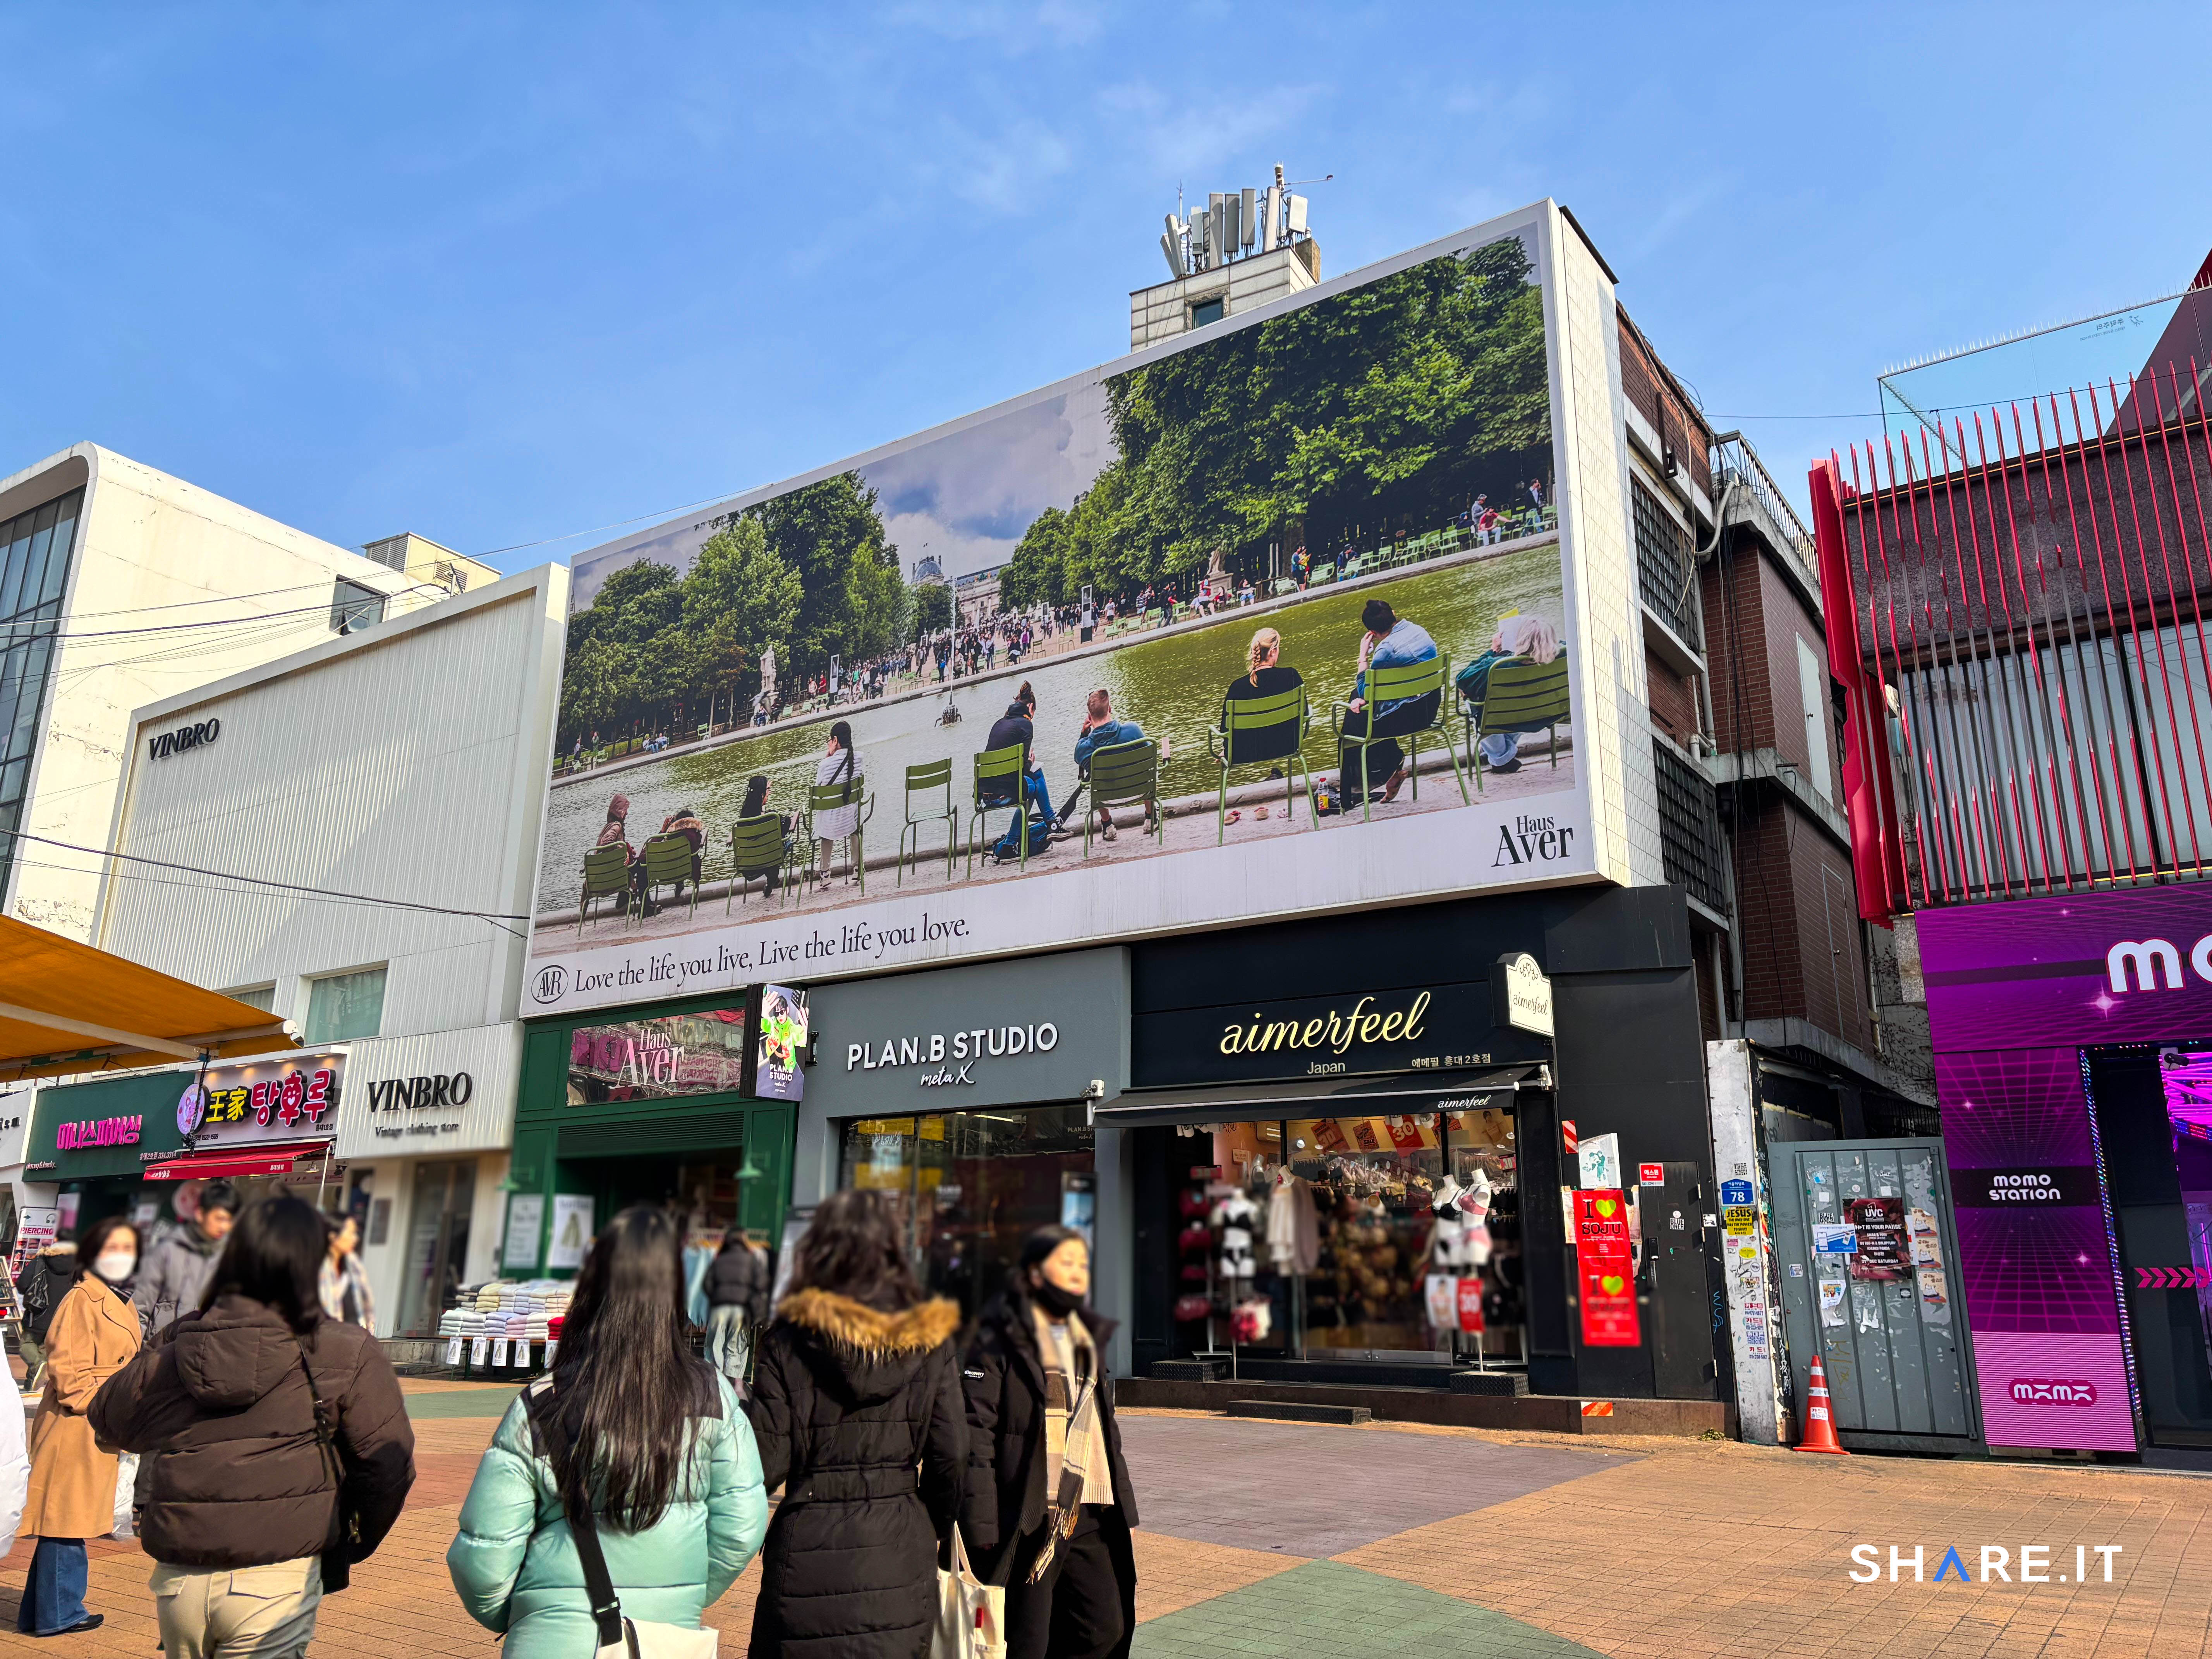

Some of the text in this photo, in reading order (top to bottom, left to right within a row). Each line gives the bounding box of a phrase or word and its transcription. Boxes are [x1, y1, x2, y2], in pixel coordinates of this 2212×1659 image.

[149, 718, 220, 760] VINBRO
[1516, 815, 1554, 834] Haus
[1491, 825, 1573, 867] Aver
[574, 912, 970, 993] Love the life you live, Live the life you love.
[1513, 992, 1548, 1015] aimerfeel
[1220, 991, 1432, 1054] aimerfeel
[638, 1028, 671, 1053] Haus
[847, 1022, 1059, 1071] PLAN.B STUDIO
[615, 1037, 685, 1089] Aver
[770, 1063, 793, 1073] PLAN.B
[1307, 1061, 1345, 1075] Japan
[1412, 1056, 1439, 1068] 에메필
[769, 1072, 793, 1081] STUDIO
[920, 1064, 955, 1087] meta
[367, 1072, 472, 1113] VINBRO
[1437, 1094, 1492, 1108] aimerfeel
[375, 1122, 459, 1139] Vintage clothing store
[1392, 1121, 1415, 1141] 30
[1730, 1192, 1745, 1202] 78
[1583, 1199, 1594, 1219] I
[1726, 1209, 1751, 1218] JESUS
[1865, 1209, 1884, 1217] UVC
[1582, 1221, 1622, 1235] SOJU
